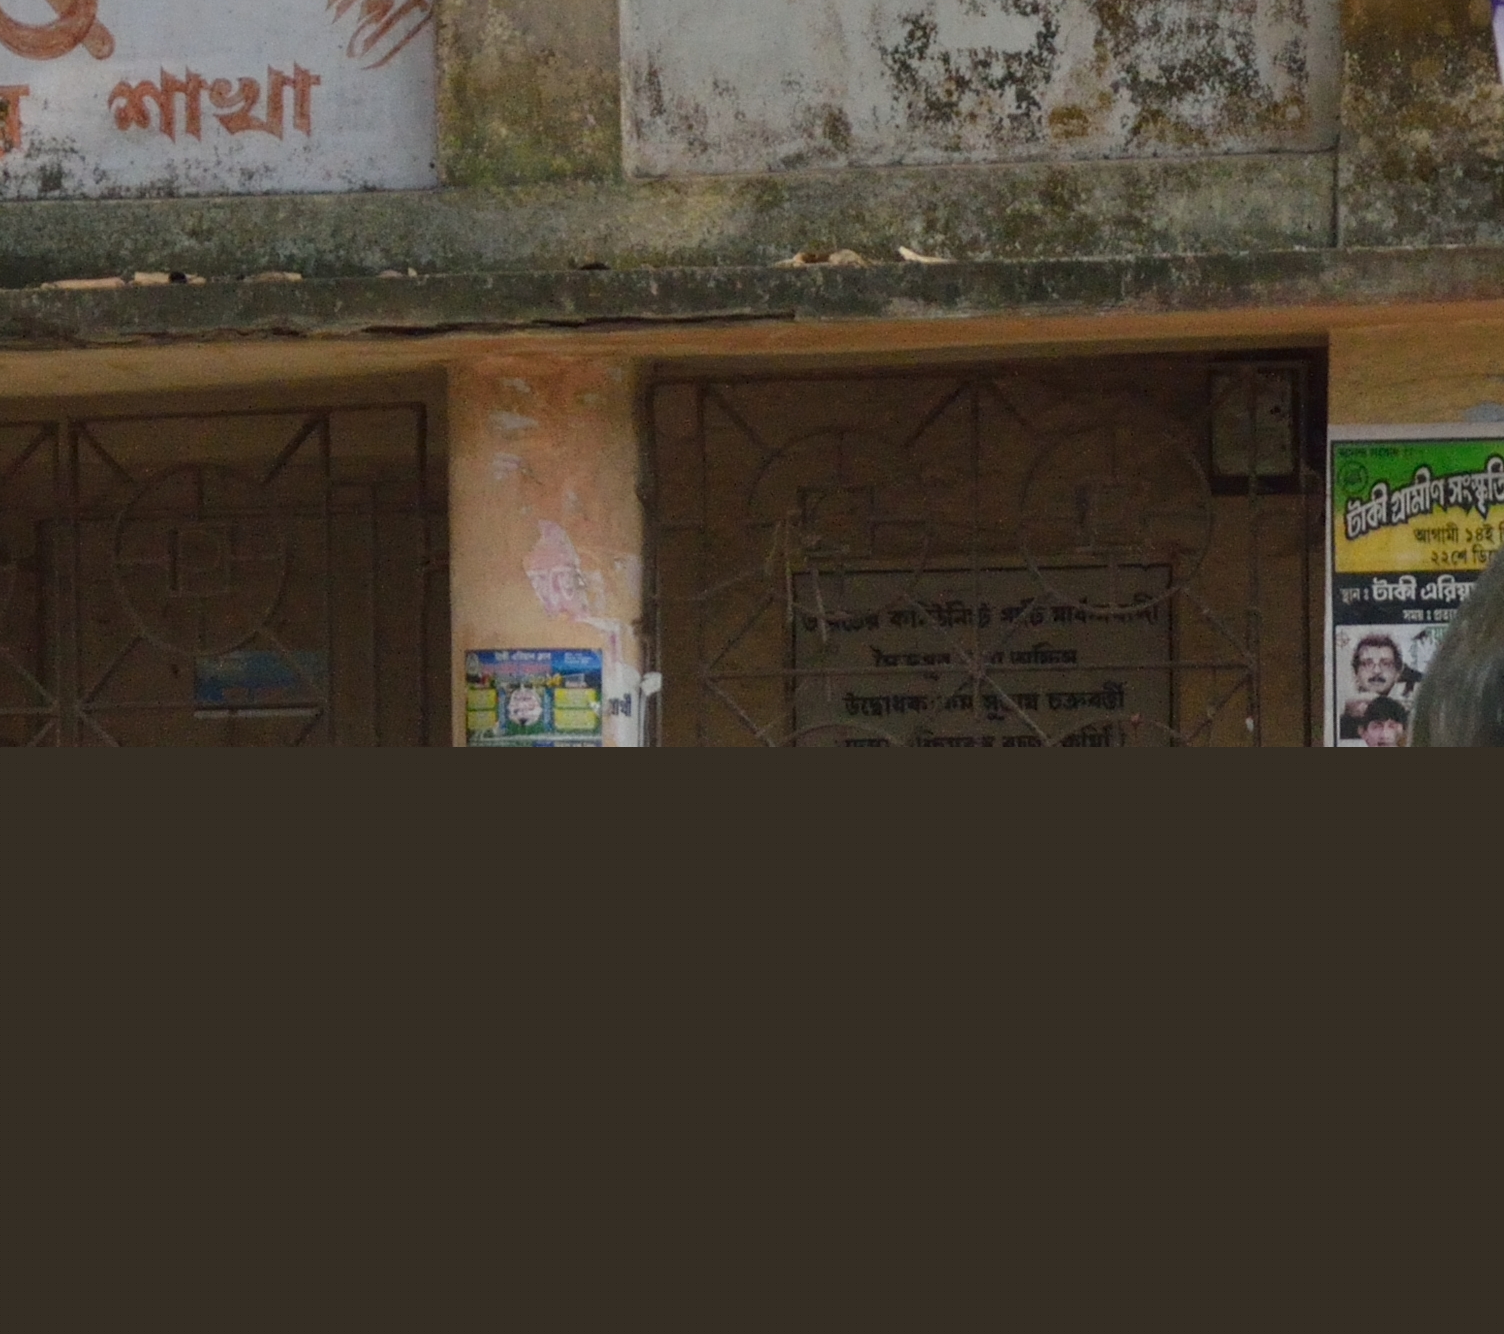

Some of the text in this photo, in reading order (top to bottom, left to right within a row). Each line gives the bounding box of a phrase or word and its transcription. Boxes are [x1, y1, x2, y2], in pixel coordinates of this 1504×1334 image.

[108, 61, 322, 144] শাখা
[1346, 482, 1389, 538] টাকী
[1391, 467, 1445, 523] গ্রামীণ
[1414, 521, 1459, 544] আগামী
[1371, 575, 1417, 602] টাকী
